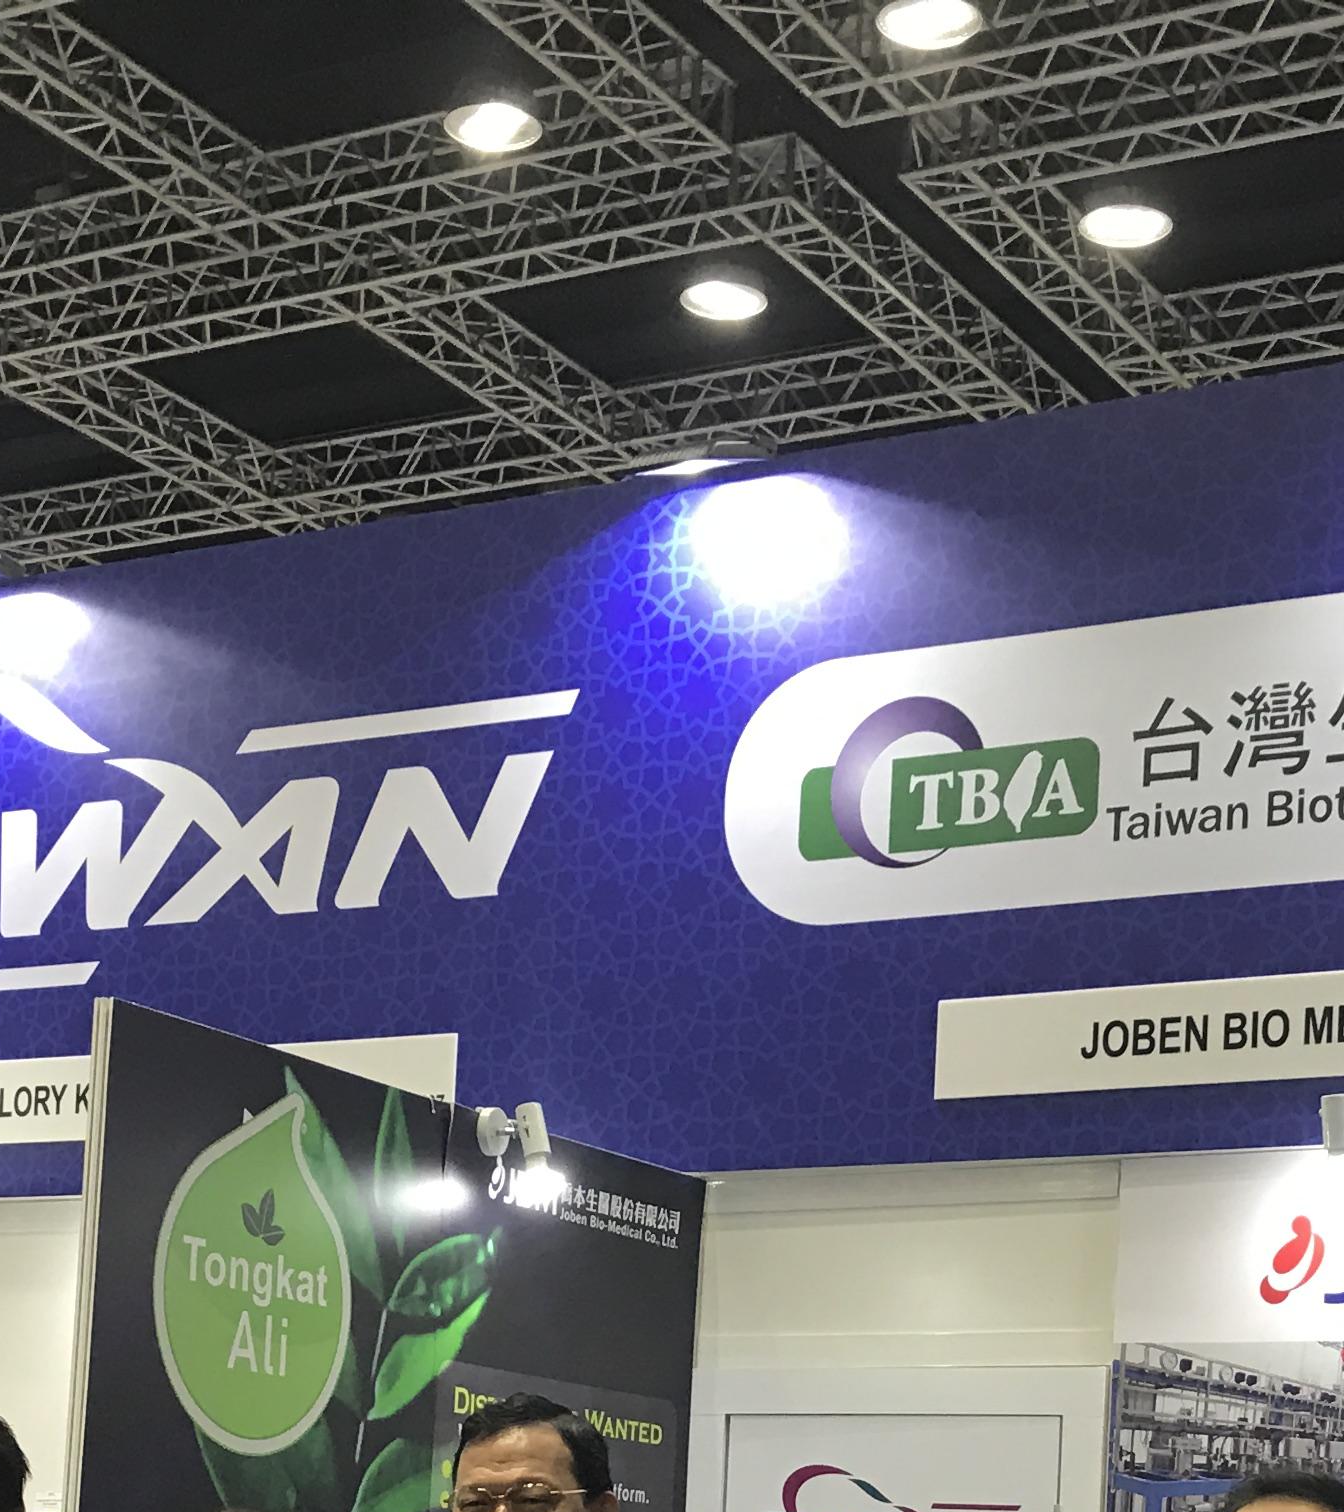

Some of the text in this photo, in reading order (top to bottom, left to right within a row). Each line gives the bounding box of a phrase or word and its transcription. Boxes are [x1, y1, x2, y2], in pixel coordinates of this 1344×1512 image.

[1106, 800, 1250, 843] Taiwan
[1079, 1013, 1210, 1060] JOBEN
[1222, 1008, 1290, 1051] BIO
[559, 1206, 588, 1228] Joben
[182, 1234, 329, 1308] Tongkat
[226, 1308, 290, 1378] Ali
[584, 1407, 664, 1446] WANTED
